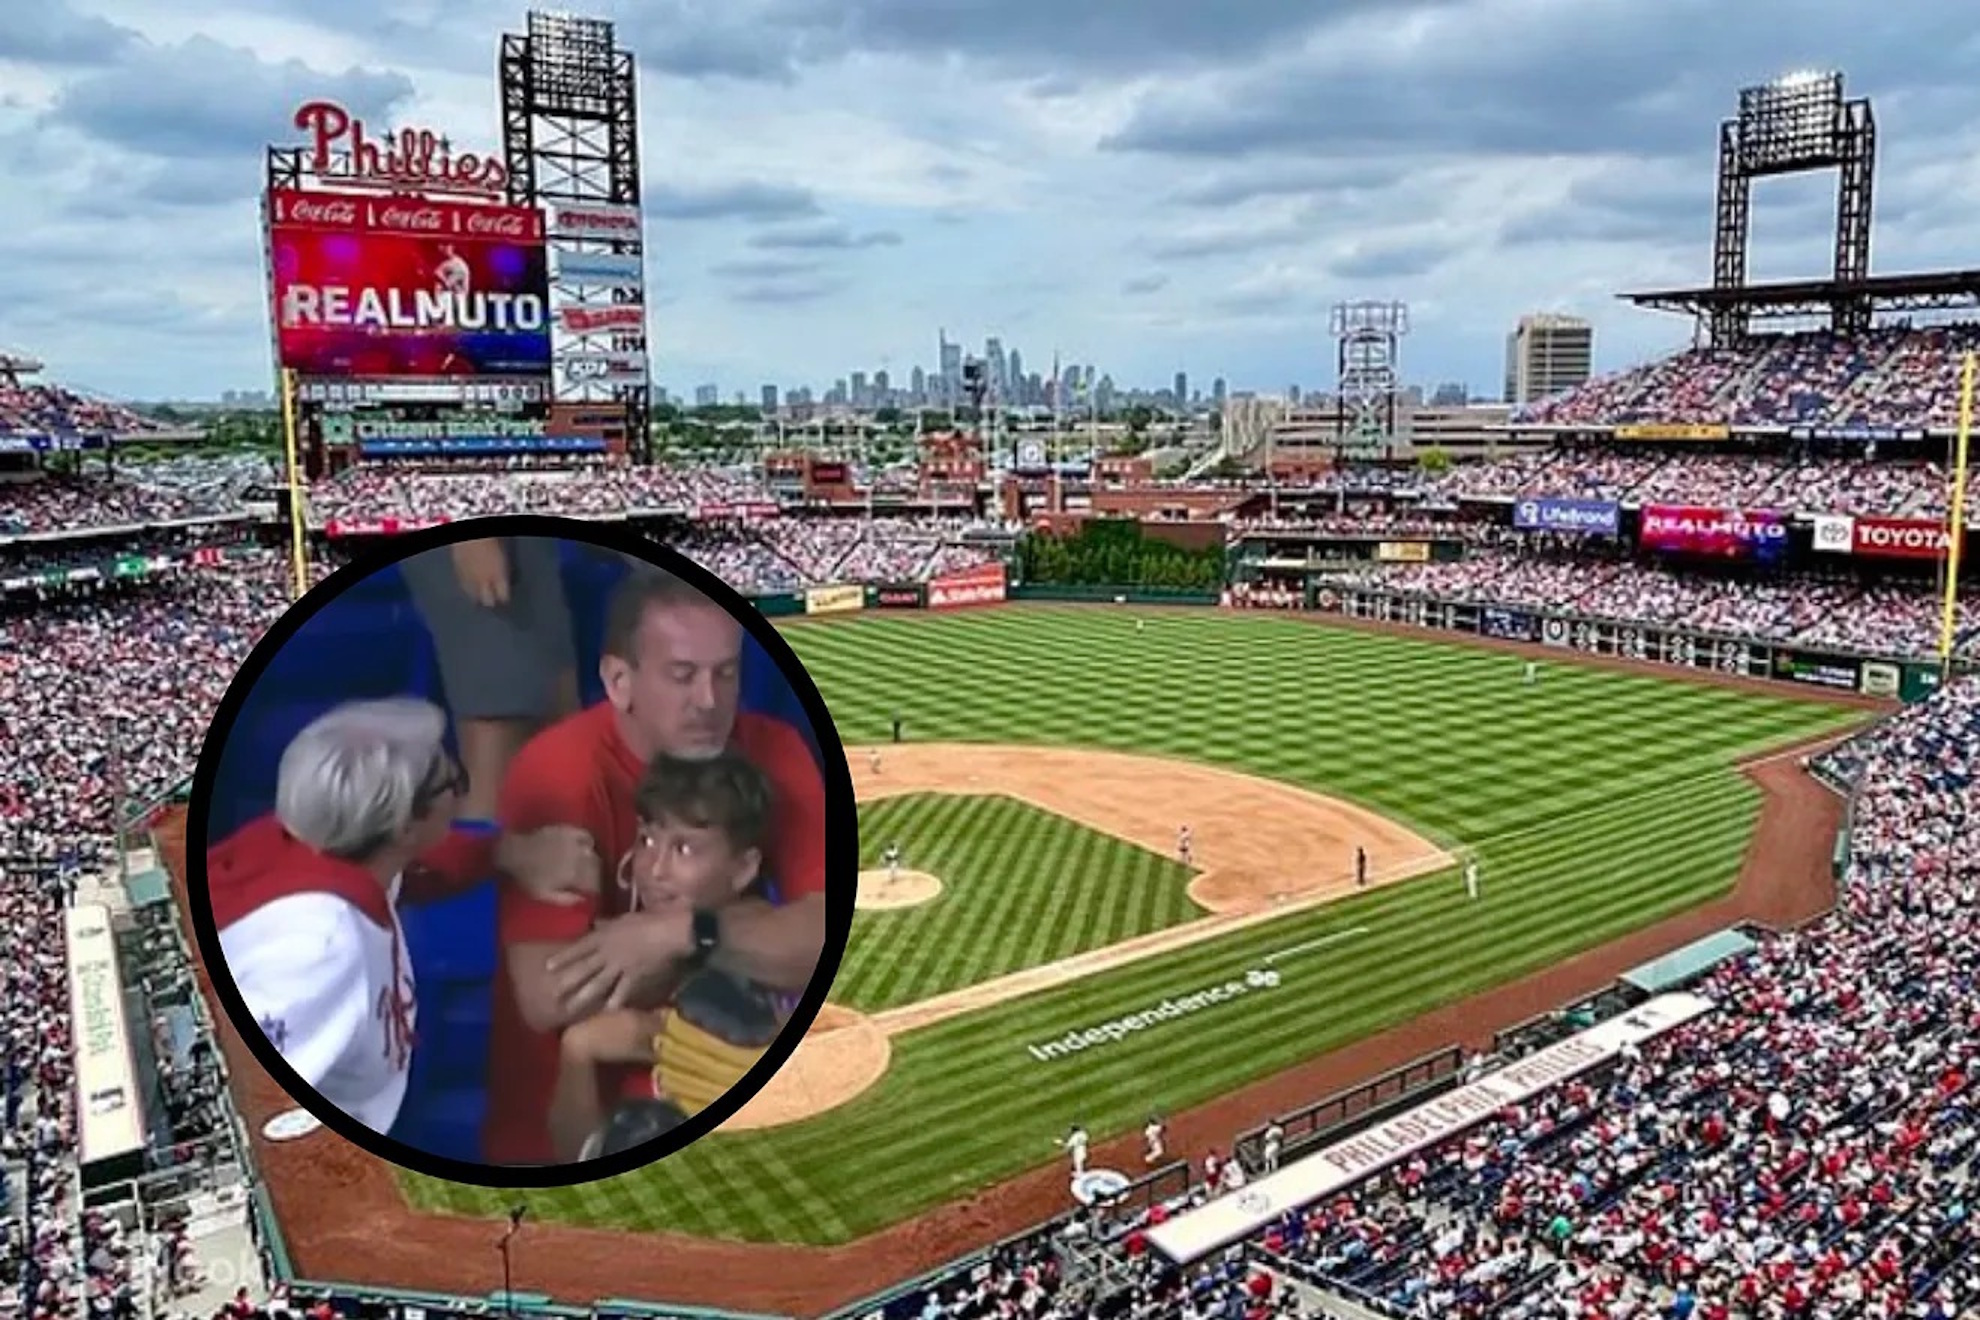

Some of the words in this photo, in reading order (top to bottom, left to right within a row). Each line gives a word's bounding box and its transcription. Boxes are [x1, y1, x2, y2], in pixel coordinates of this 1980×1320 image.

[294, 101, 509, 189] Phillies
[284, 284, 543, 330] REALMUTO
[1644, 516, 1786, 540] REALMUTO
[1859, 524, 1951, 550] TOYOTA
[1028, 981, 1248, 1062] Independence
[1323, 1083, 1507, 1174] PHILADELPHIA
[1502, 1038, 1605, 1089] PHILLIES
